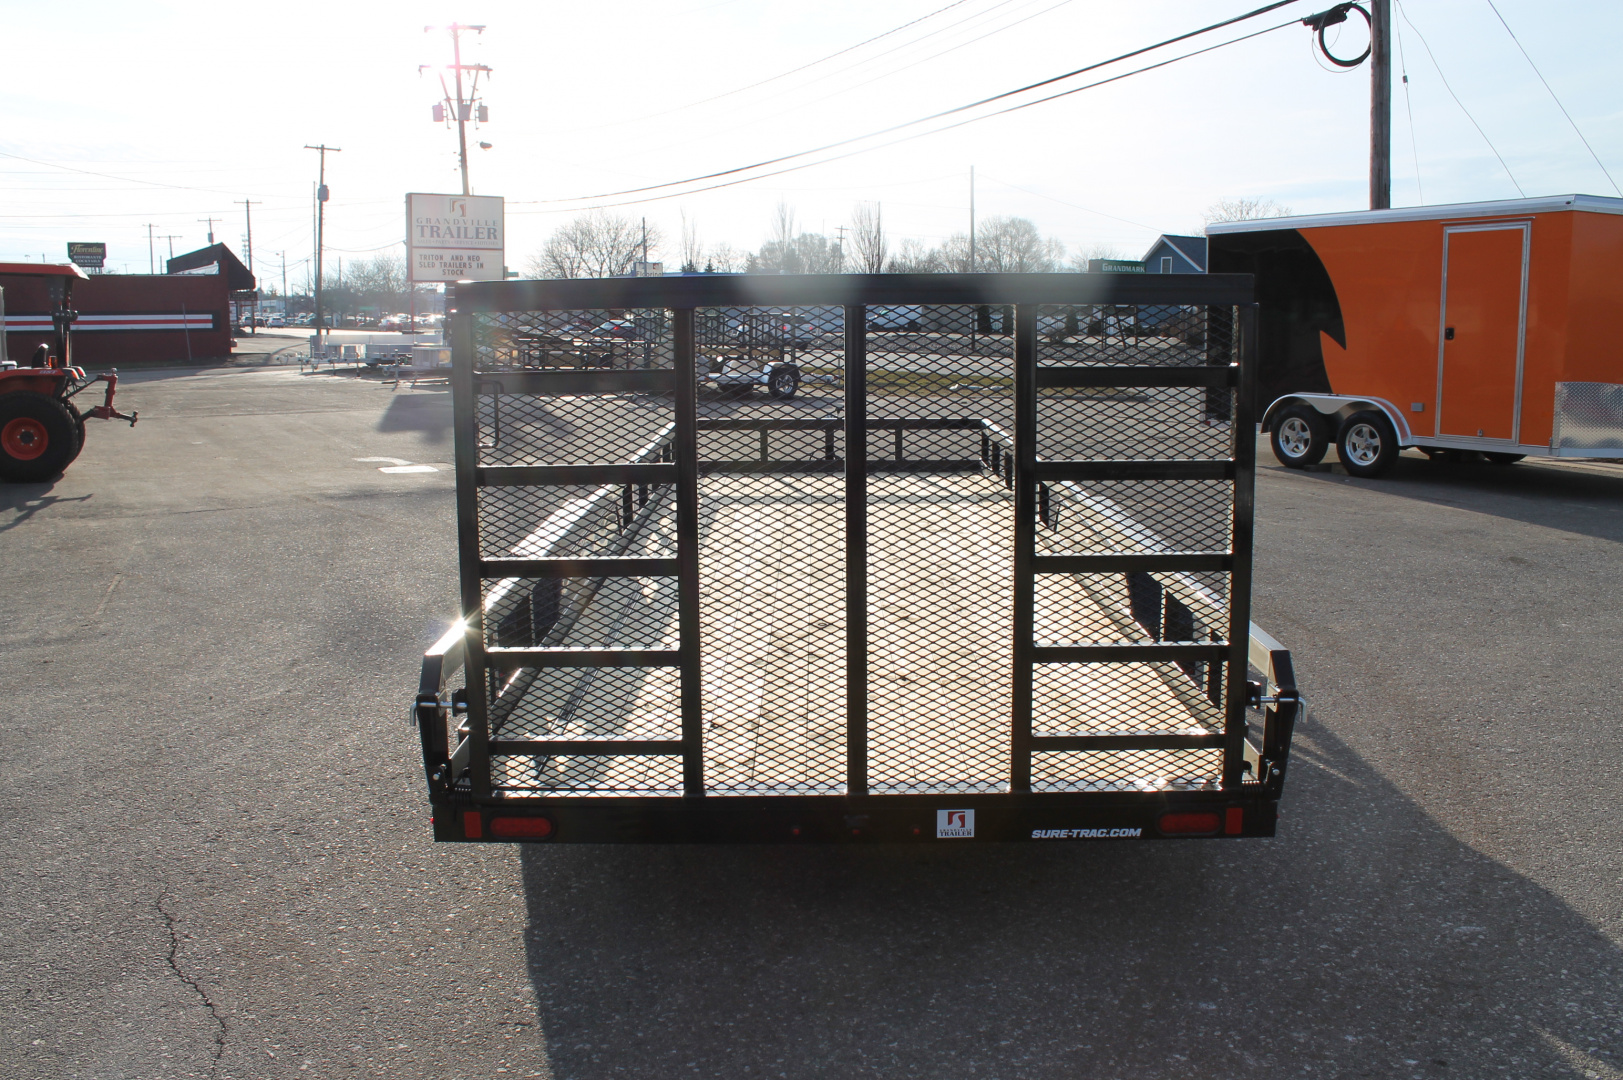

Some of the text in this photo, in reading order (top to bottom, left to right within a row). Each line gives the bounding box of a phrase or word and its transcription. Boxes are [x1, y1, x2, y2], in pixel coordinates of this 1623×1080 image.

[416, 217, 498, 226] GRANDVILLE
[416, 225, 498, 240] TRAILER
[1102, 262, 1146, 273] GRANDMARK
[1031, 828, 1142, 838] SURE-TRAC.COM
